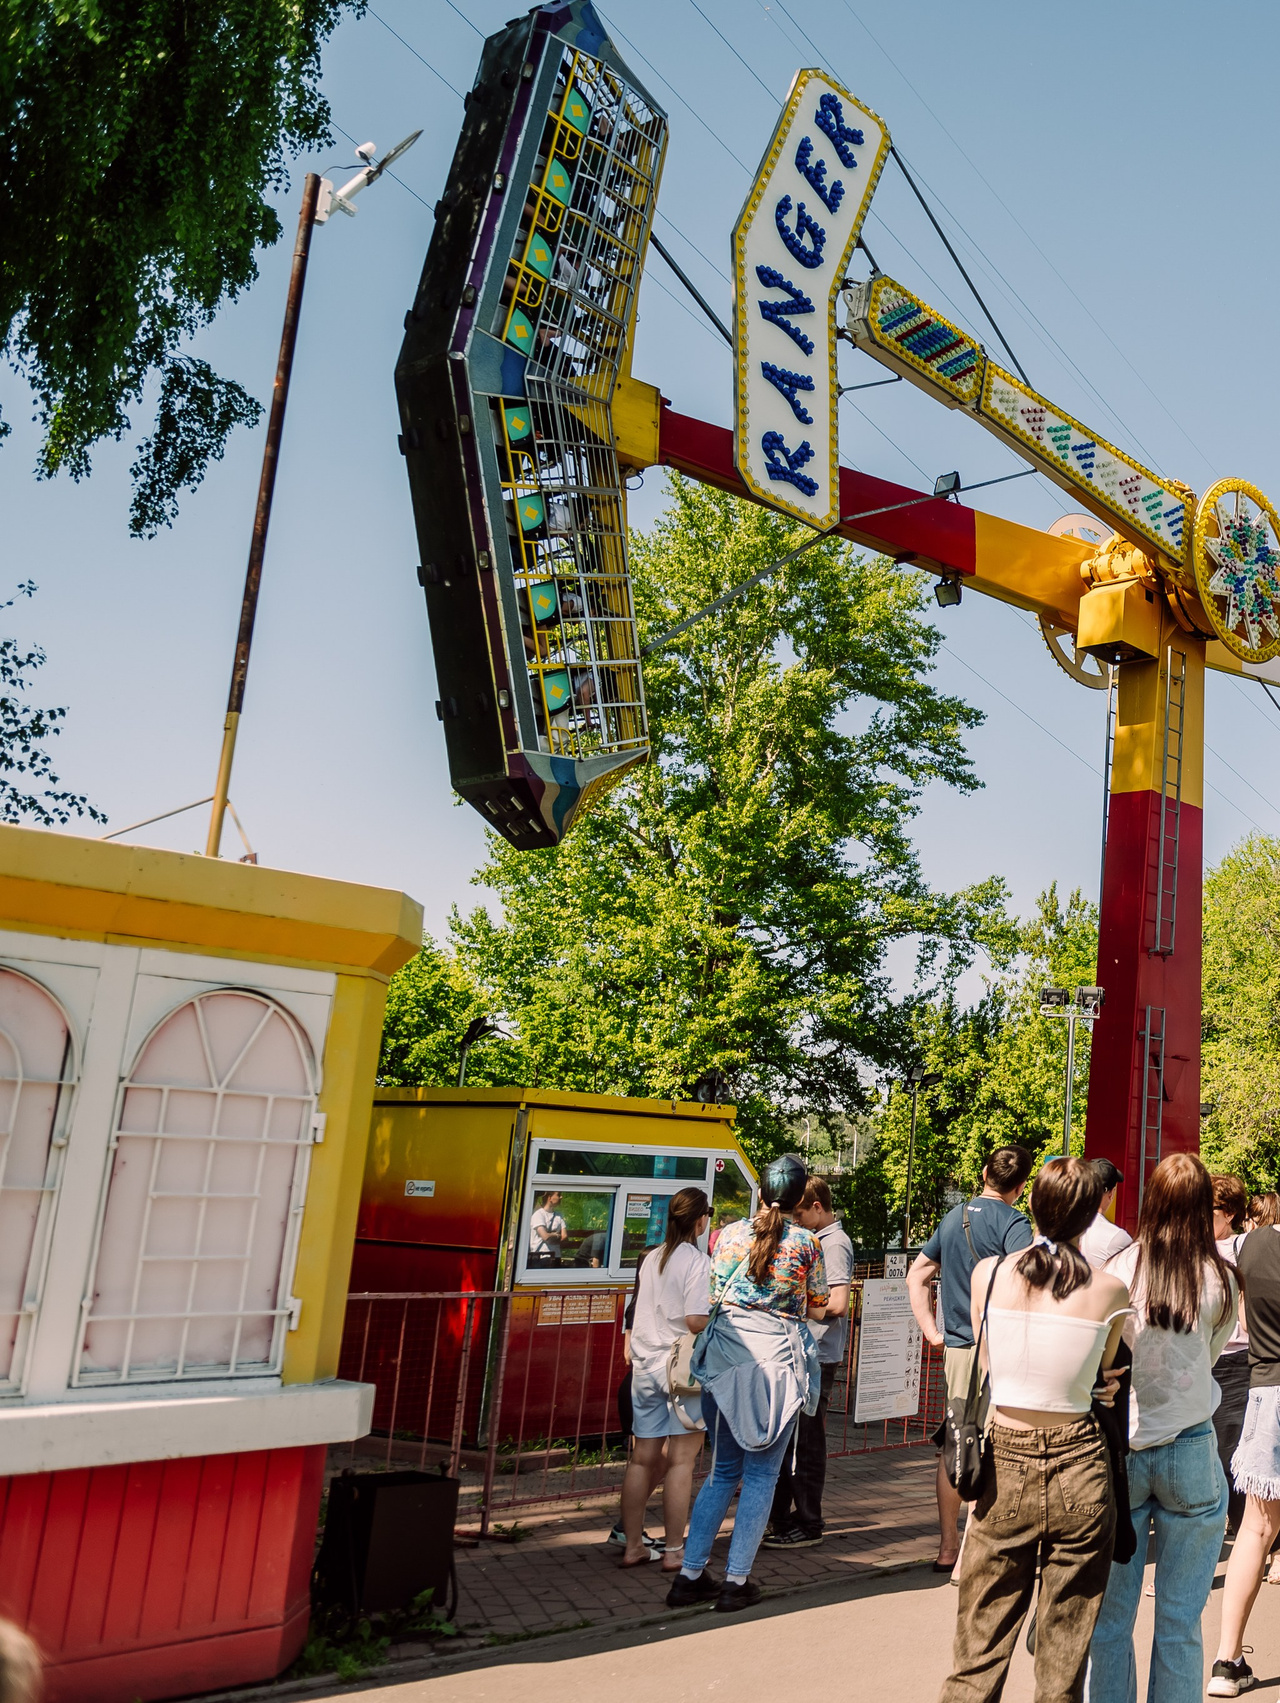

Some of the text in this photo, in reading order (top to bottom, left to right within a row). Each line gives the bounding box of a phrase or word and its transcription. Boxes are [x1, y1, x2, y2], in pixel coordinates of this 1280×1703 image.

[755, 92, 865, 498] RANGER
[890, 1256, 898, 1265] 42
[889, 1269, 904, 1277] 0076
